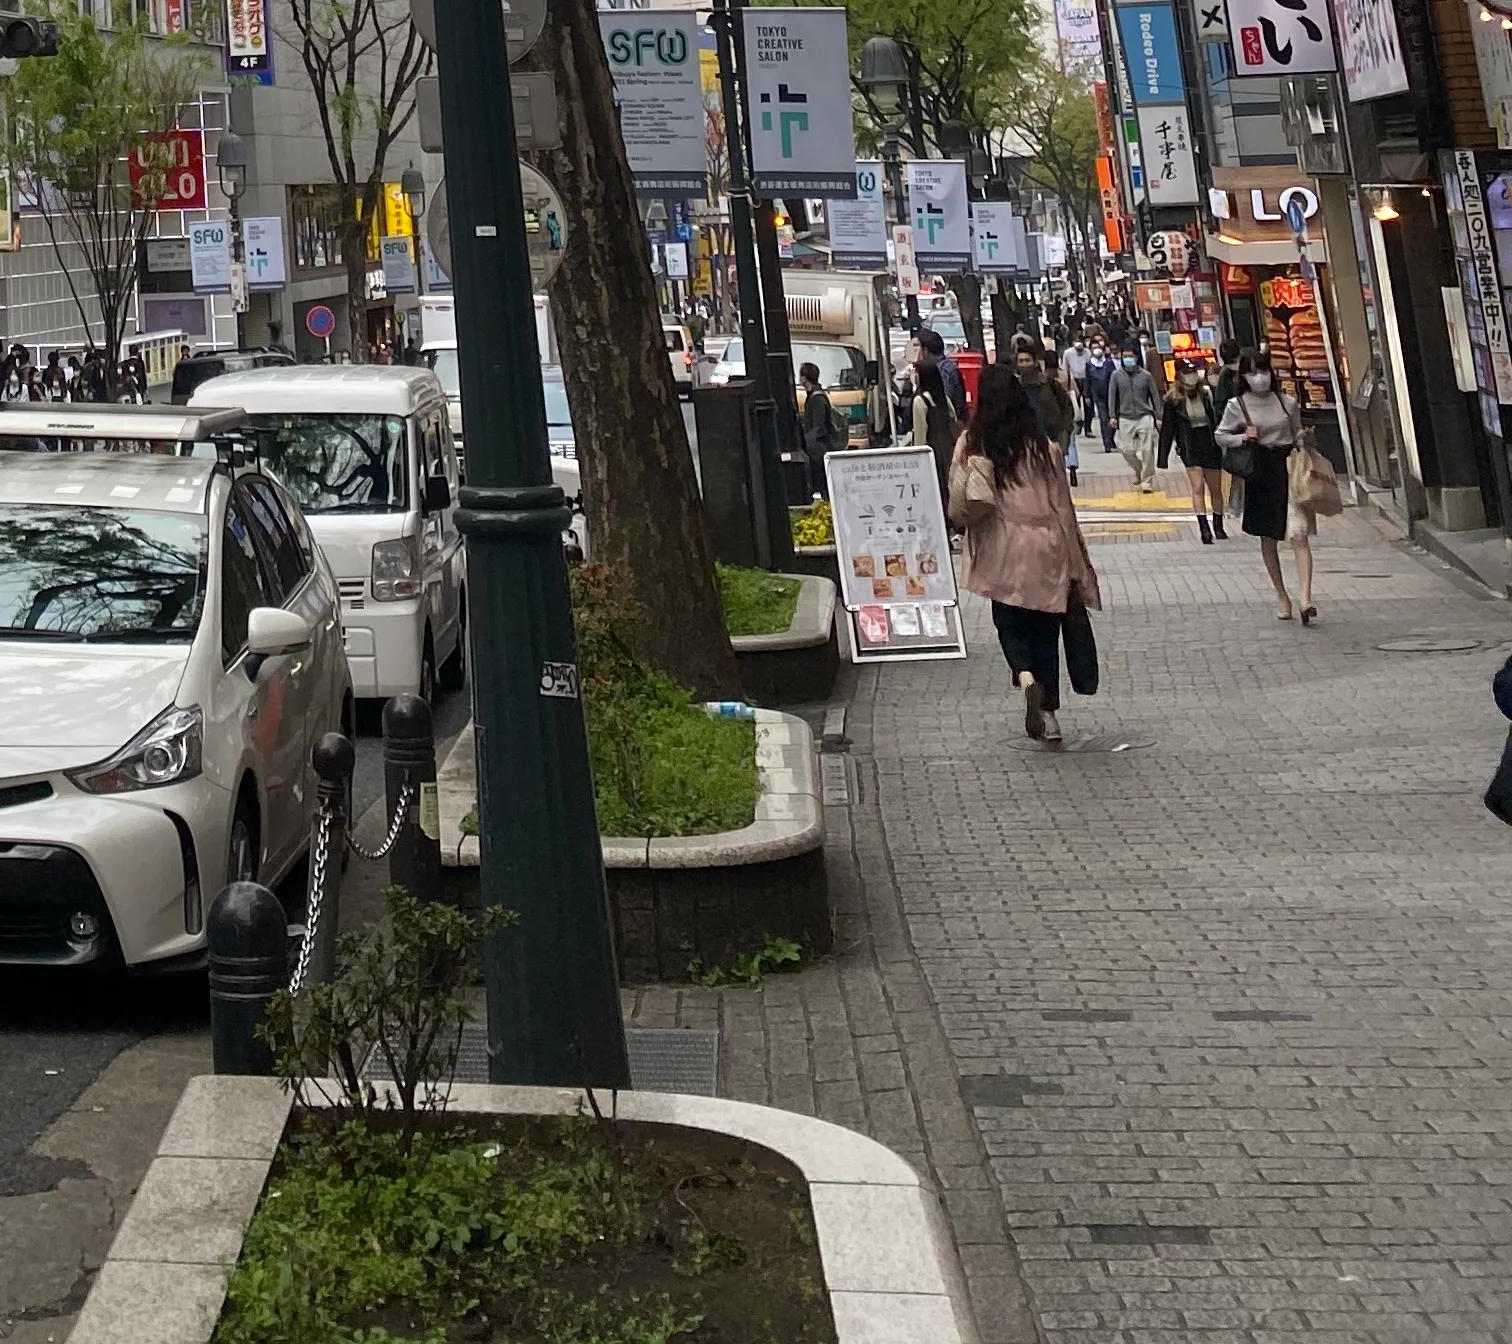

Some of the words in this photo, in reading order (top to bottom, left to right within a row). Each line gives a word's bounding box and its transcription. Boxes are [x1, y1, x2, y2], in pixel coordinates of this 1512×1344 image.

[756, 25, 787, 37] TOKYO
[1139, 13, 1154, 57] Rodeo
[757, 38, 804, 50] CREATIVE
[239, 56, 259, 69] 4F
[758, 51, 789, 63] SALON
[1145, 59, 1161, 96] Drive
[137, 138, 190, 169] UNI
[896, 231, 913, 289] 道玄坂
